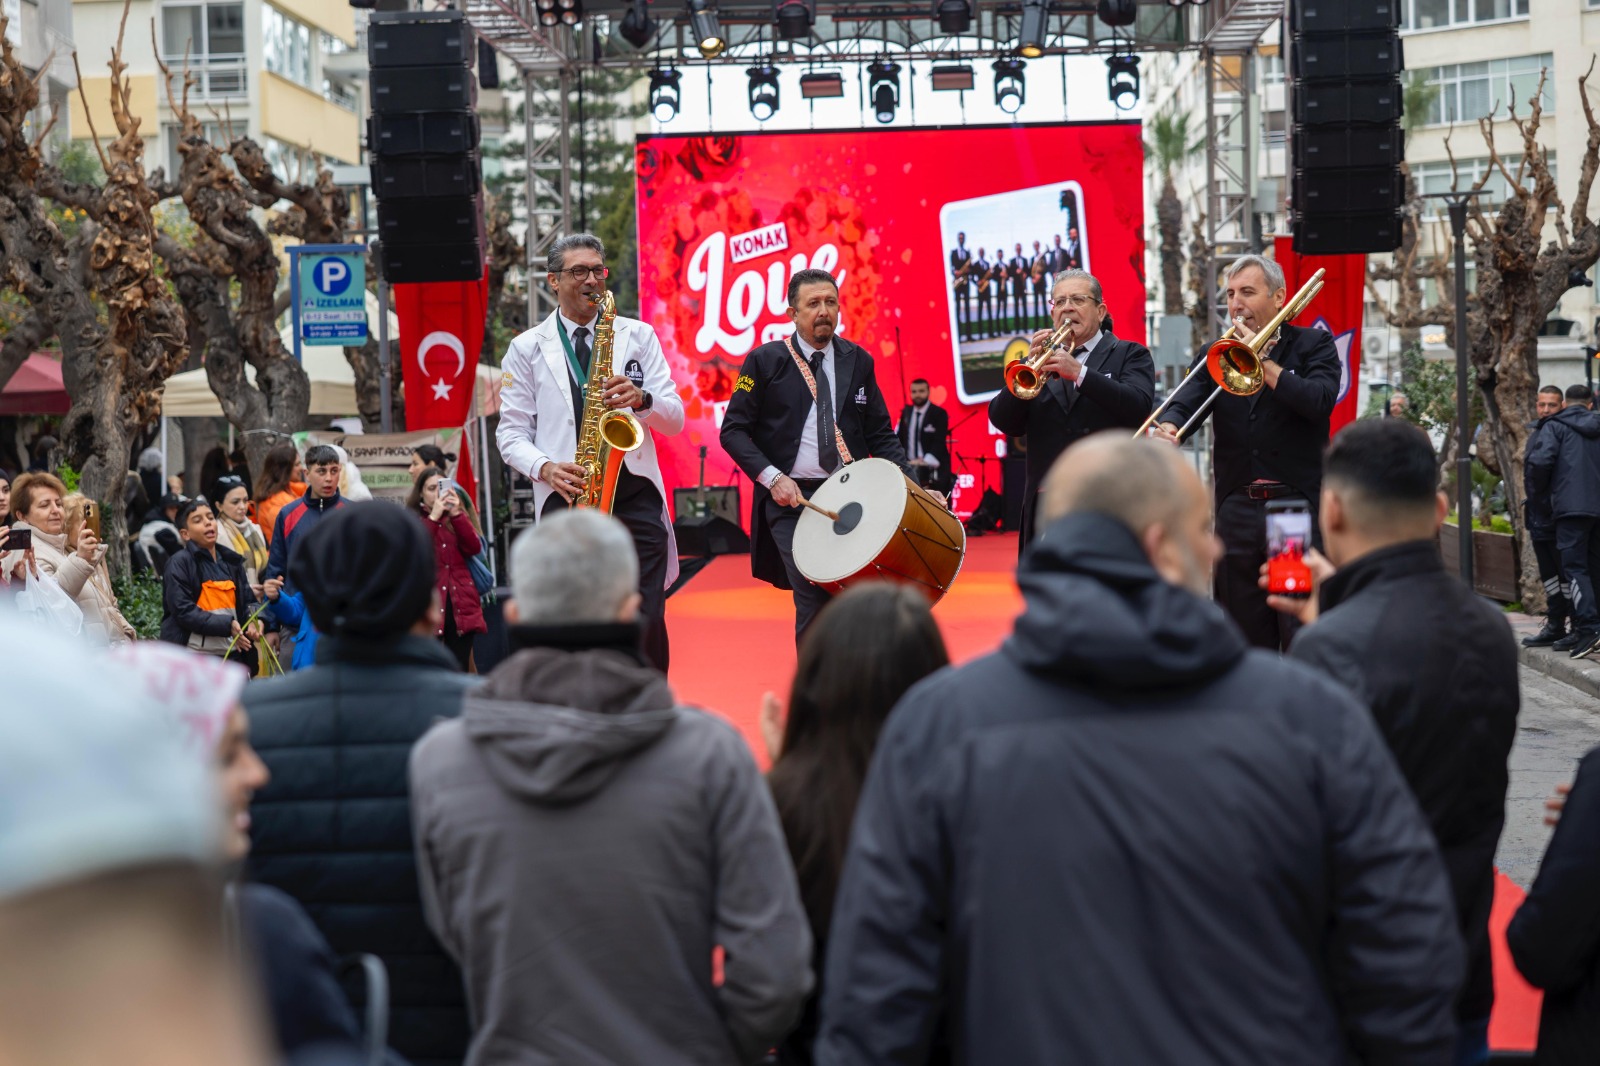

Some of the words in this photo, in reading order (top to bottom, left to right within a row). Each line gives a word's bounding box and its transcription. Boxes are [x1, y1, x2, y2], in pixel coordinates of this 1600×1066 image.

[733, 228, 784, 258] KONAK
[322, 262, 347, 292] P
[316, 297, 363, 307] İZELMAN
[687, 231, 847, 356] Love
[354, 447, 384, 458] SANAT
